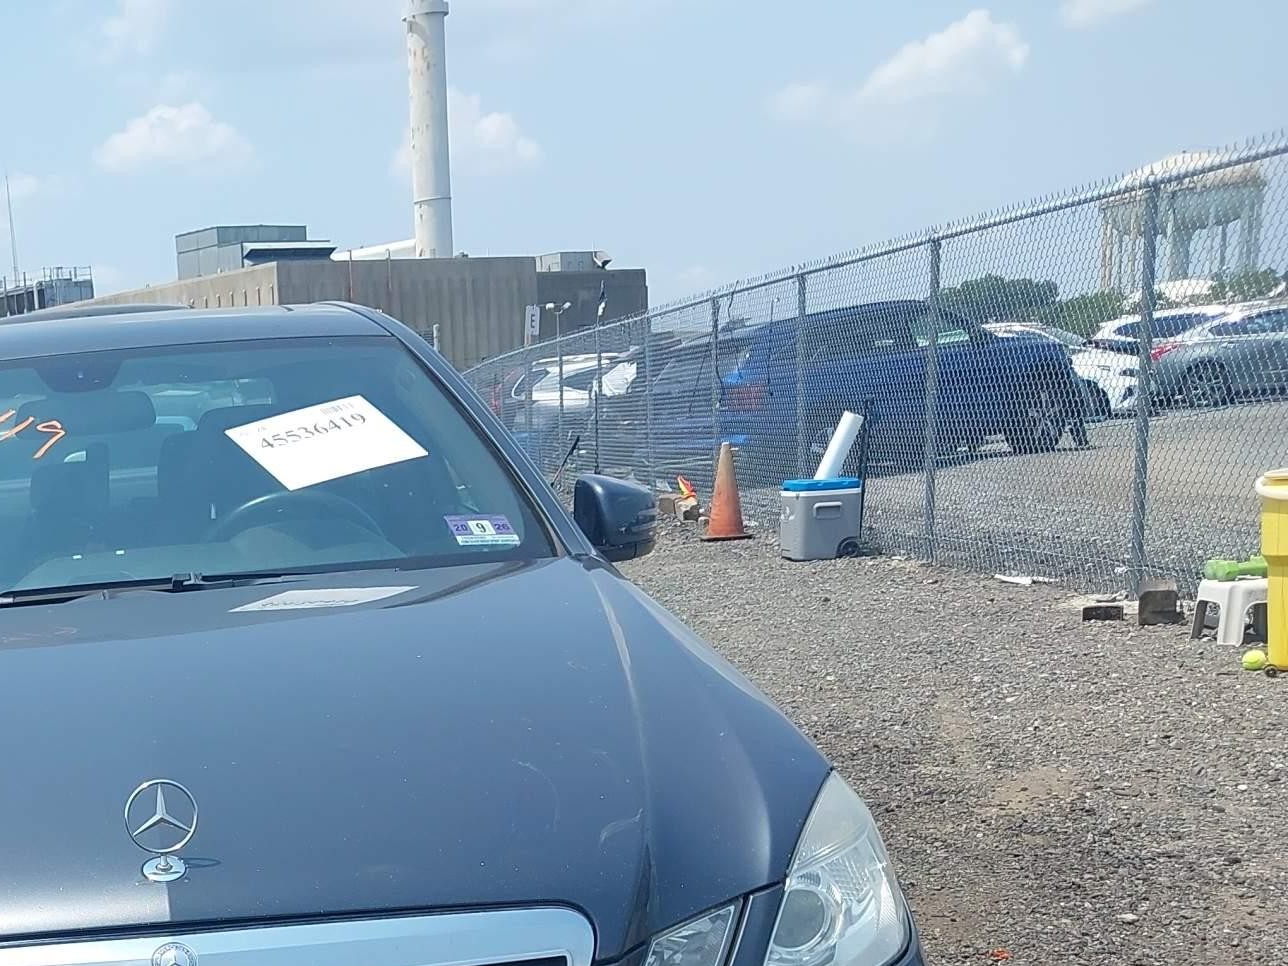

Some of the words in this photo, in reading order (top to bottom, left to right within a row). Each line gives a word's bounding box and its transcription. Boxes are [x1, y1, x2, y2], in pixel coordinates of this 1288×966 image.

[530, 313, 536, 329] E
[260, 412, 367, 449] 45536419
[453, 524, 468, 532] 20
[475, 522, 487, 533] 9
